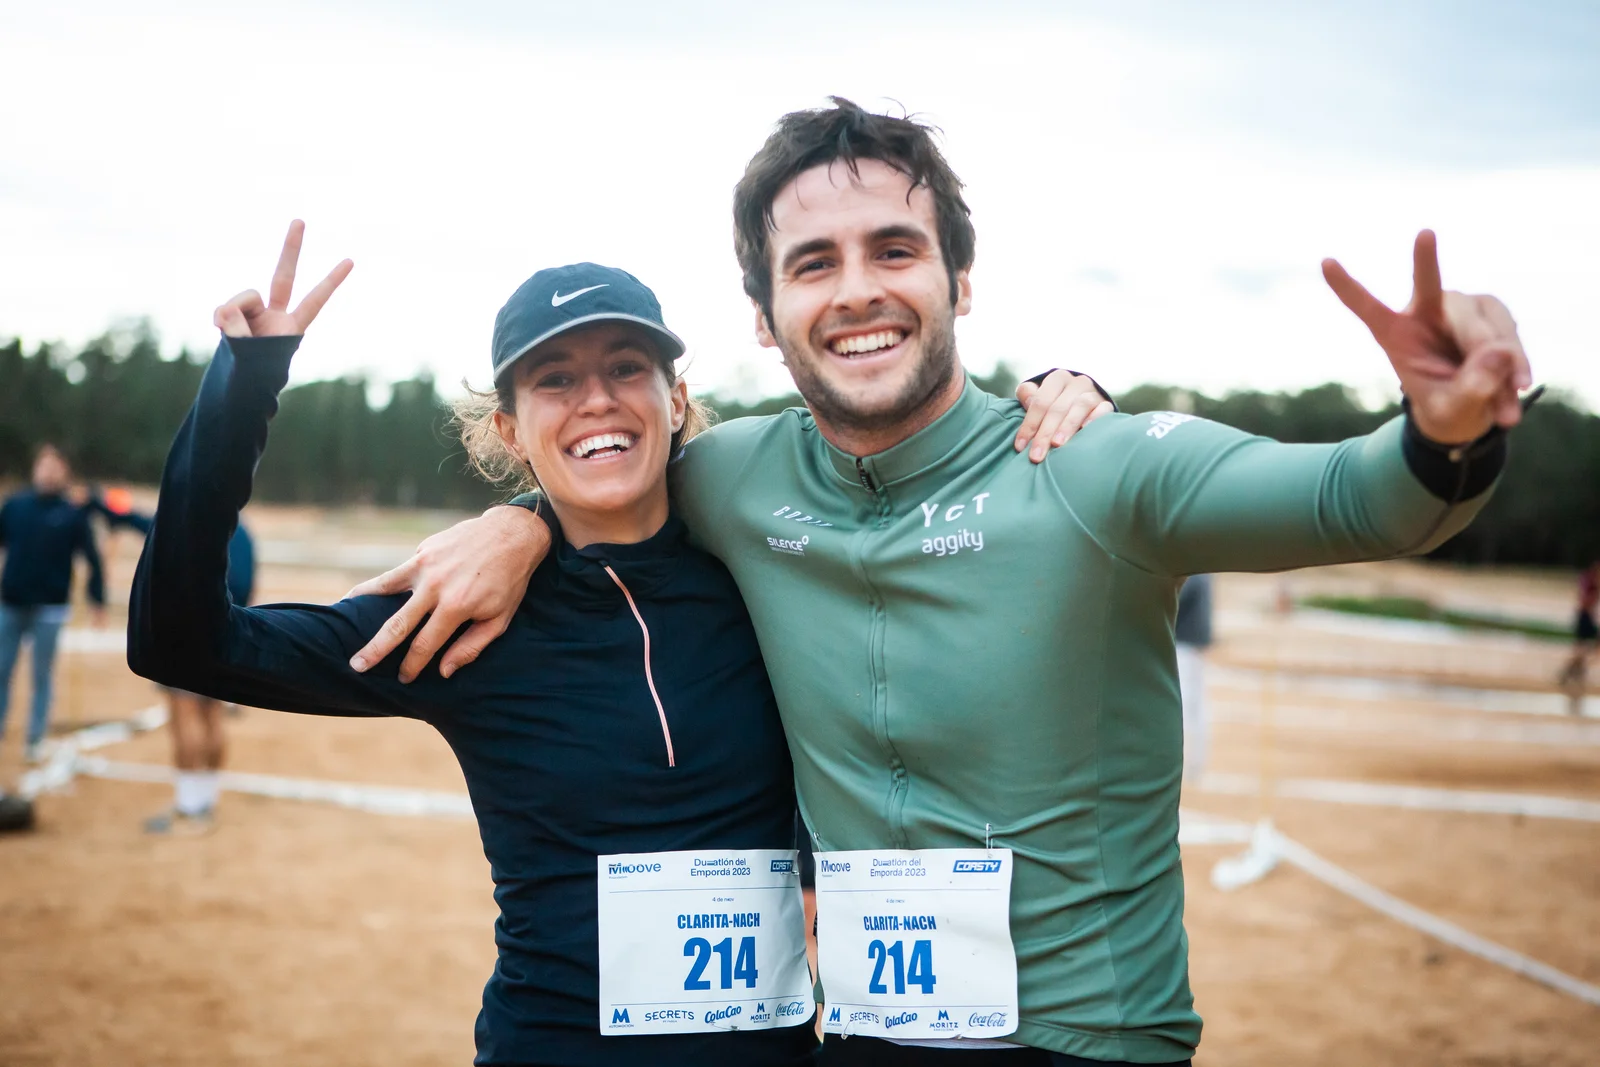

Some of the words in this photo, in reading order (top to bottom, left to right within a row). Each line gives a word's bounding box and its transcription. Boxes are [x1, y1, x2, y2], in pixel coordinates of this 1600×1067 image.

[922, 530, 983, 557] aggity
[735, 858, 747, 866] del
[909, 858, 922, 867] del
[955, 862, 999, 871] COASTY
[732, 868, 751, 876] 2023
[904, 868, 927, 877] 2023
[677, 912, 760, 930] CLARITA-NACH
[863, 915, 937, 931] CLARITA-NACH
[683, 936, 758, 991] 214
[868, 939, 937, 994] 214
[645, 1010, 695, 1022] SECRETS
[750, 1013, 771, 1021] MORITZ
[850, 1012, 879, 1024] SECRETS
